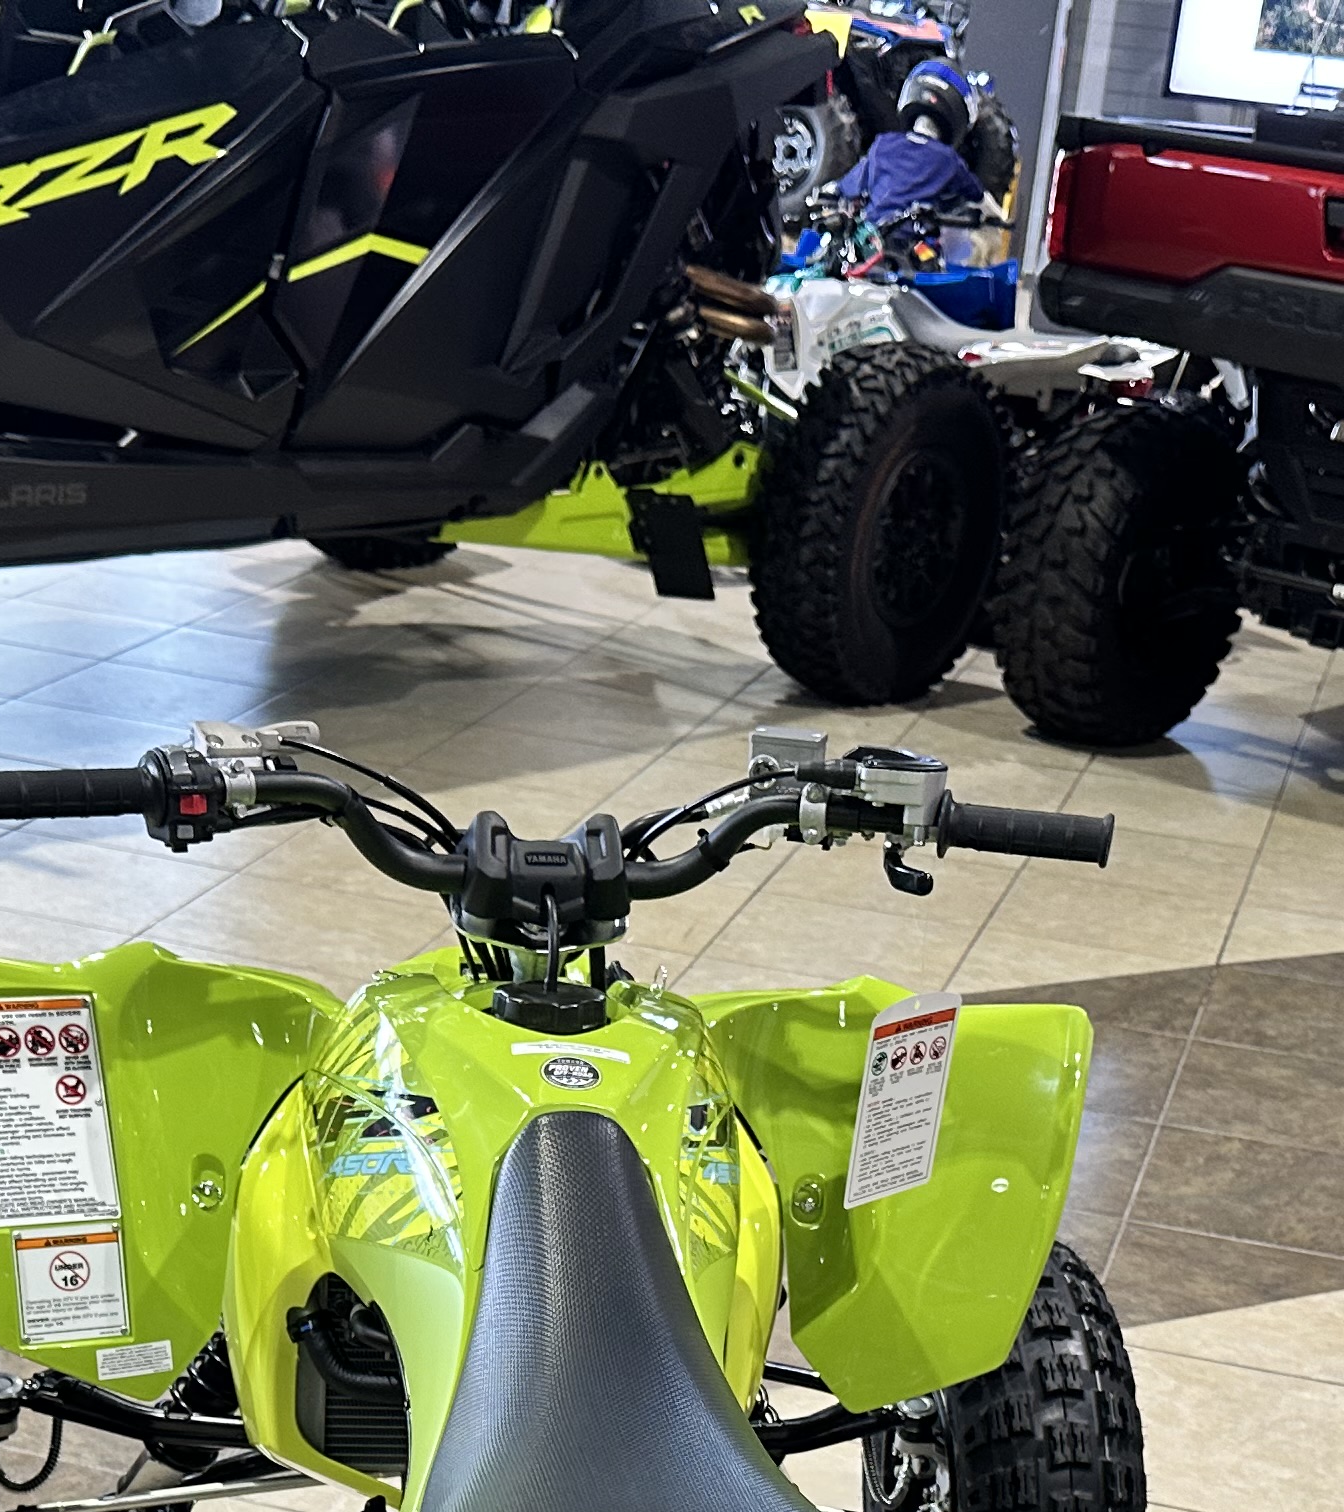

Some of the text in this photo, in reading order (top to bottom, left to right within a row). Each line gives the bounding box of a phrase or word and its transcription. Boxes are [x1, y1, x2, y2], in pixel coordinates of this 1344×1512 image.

[526, 854, 567, 865] YAMAHA
[548, 1064, 590, 1074] PROVEN
[54, 1262, 84, 1272] UNDER
[61, 1275, 79, 1287] 16
